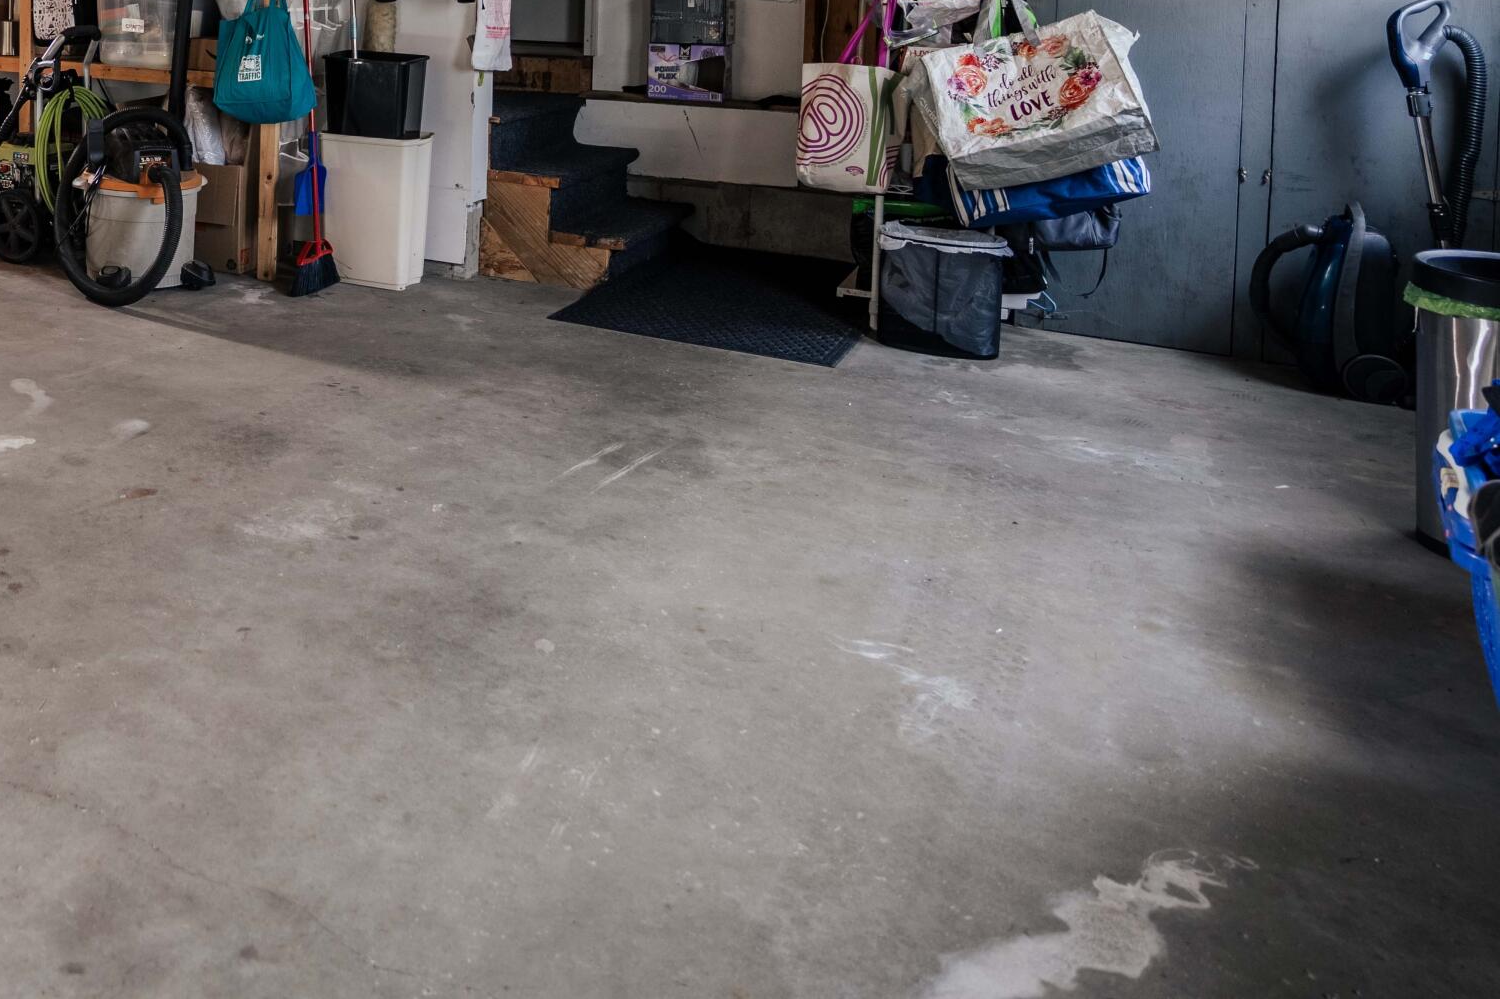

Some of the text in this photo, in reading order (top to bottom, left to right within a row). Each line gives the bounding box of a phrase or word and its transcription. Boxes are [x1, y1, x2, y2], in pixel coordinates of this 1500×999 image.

[239, 72, 261, 81] TRAFFIC
[987, 64, 1057, 107] things with
[648, 85, 667, 94] 200
[1010, 89, 1055, 121] LOVE
